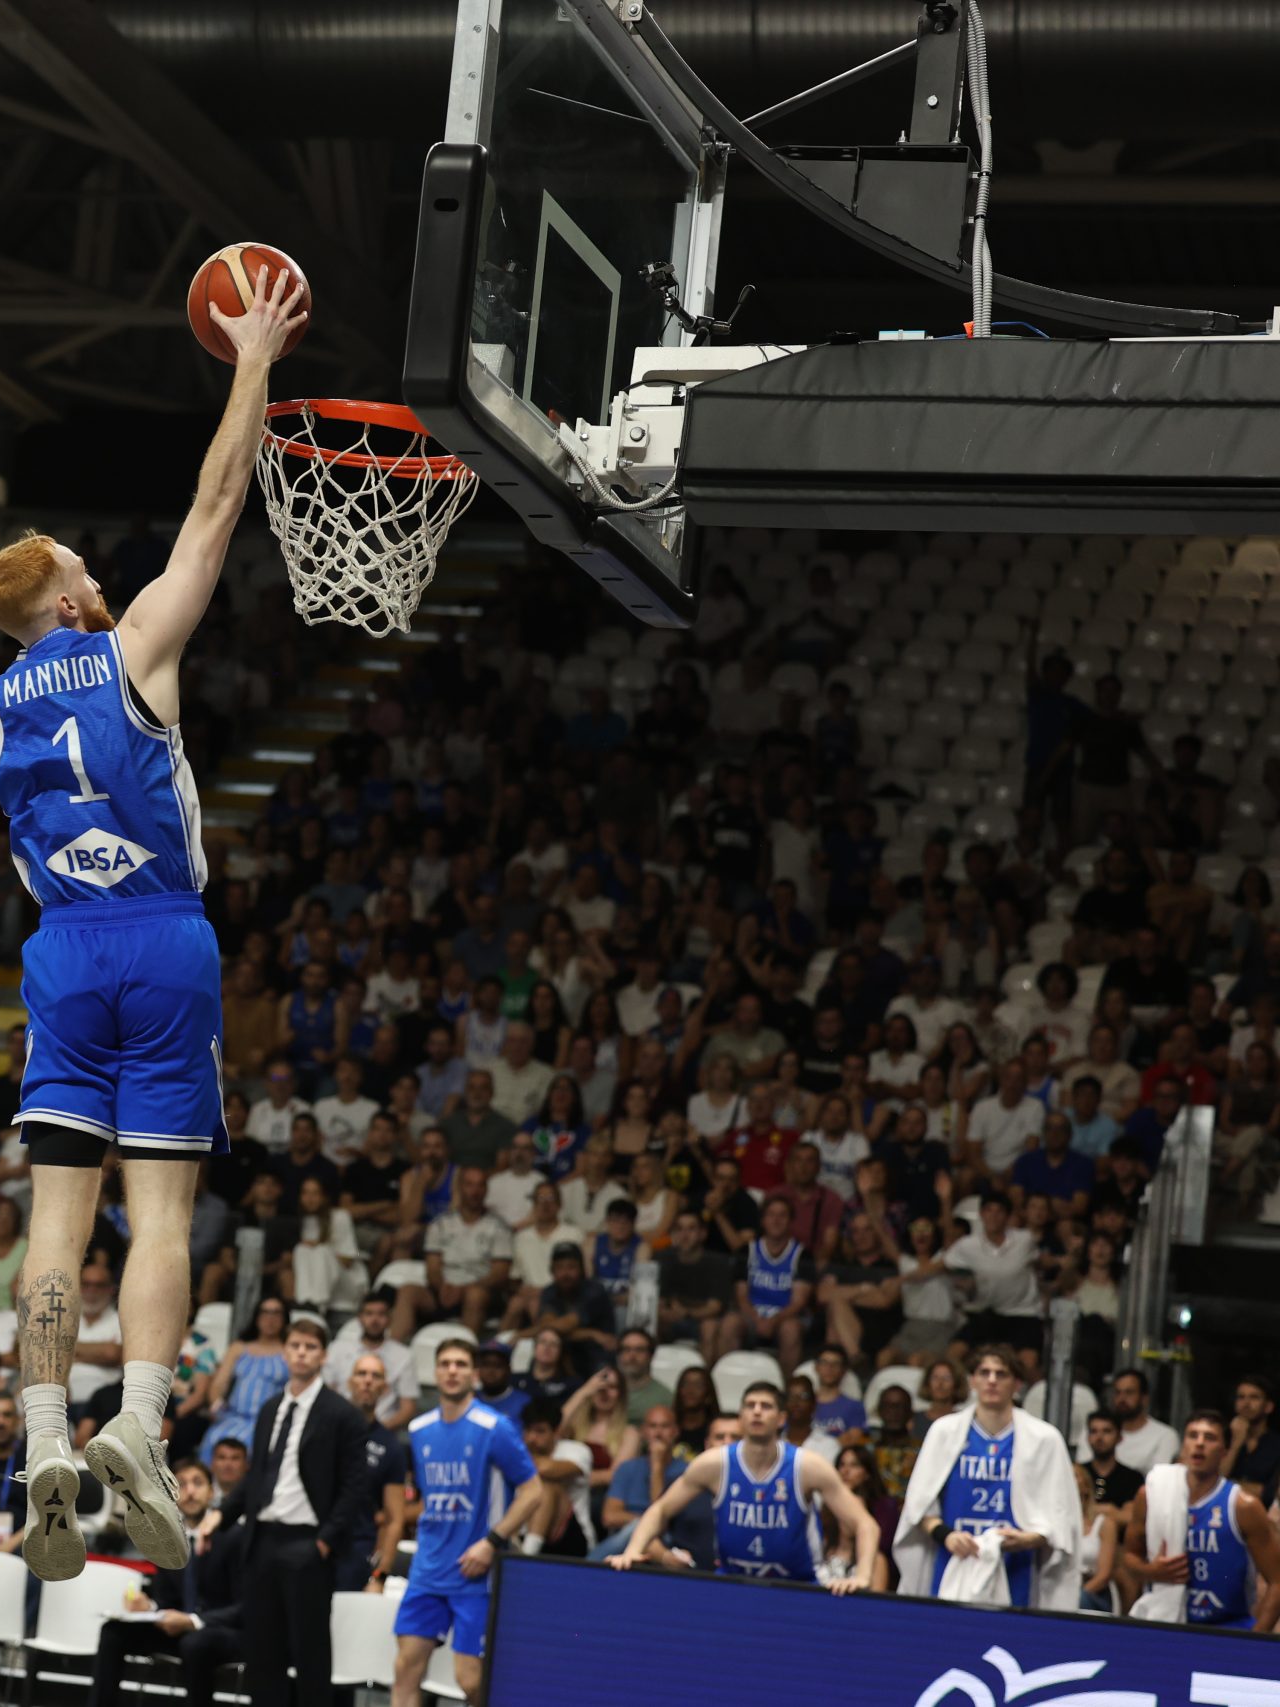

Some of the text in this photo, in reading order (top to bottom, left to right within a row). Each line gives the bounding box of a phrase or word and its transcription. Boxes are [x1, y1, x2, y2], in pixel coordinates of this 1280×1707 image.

[3, 654, 112, 708] MANNION
[52, 716, 110, 804] 1
[65, 845, 136, 873] IBSA
[425, 1462, 470, 1486] ITALIA
[971, 1487, 1005, 1512] 24
[728, 1500, 789, 1529] ITALIA
[747, 1535, 764, 1557] 4
[1187, 1529, 1219, 1554] LIA
[1194, 1558, 1208, 1582] 8
